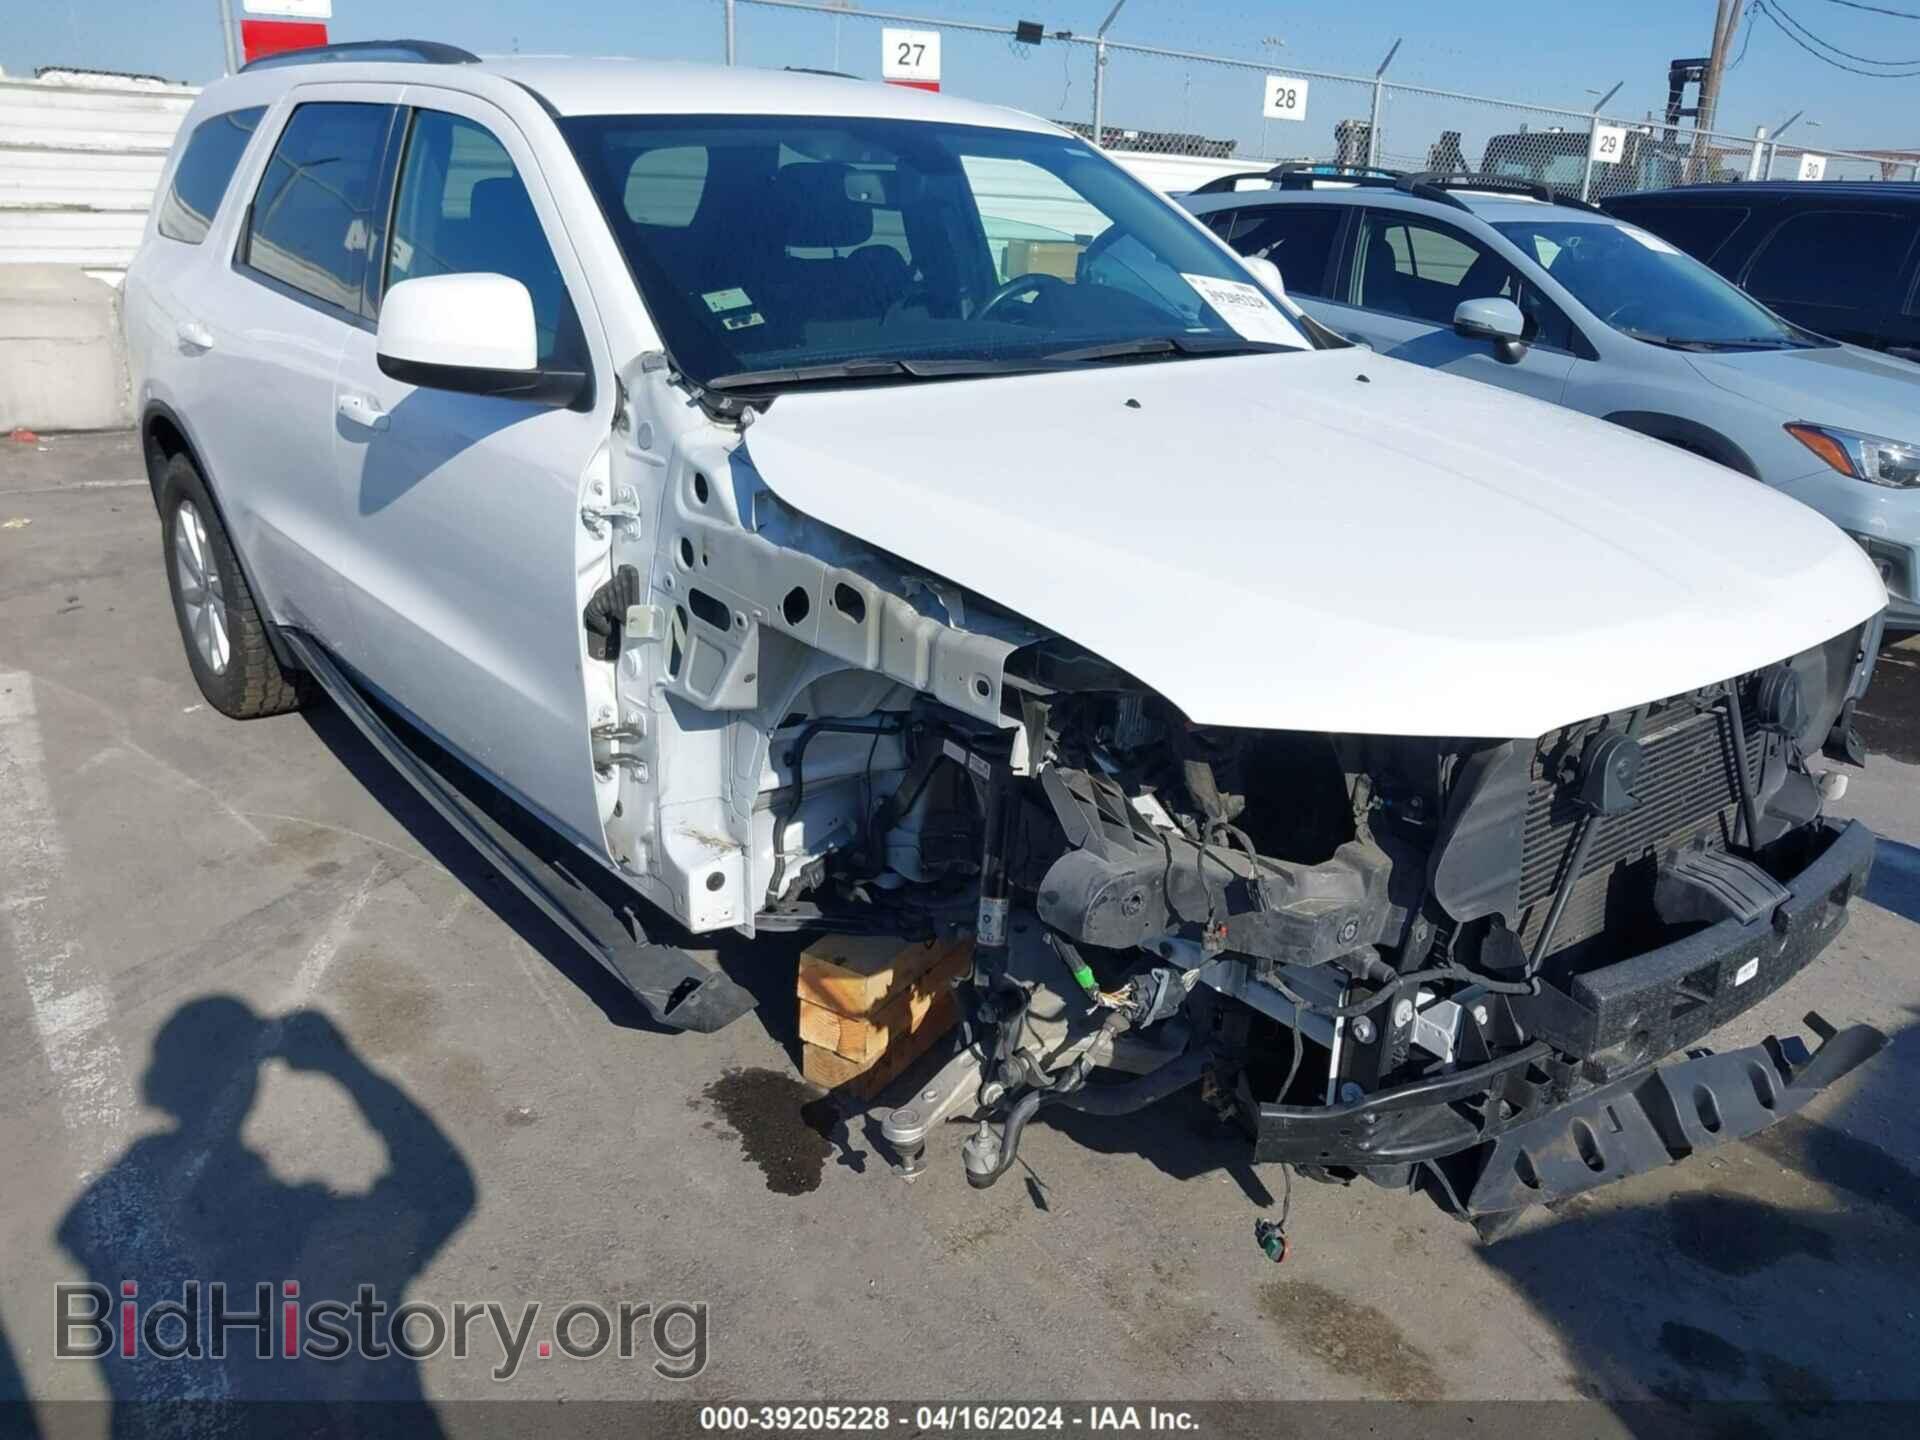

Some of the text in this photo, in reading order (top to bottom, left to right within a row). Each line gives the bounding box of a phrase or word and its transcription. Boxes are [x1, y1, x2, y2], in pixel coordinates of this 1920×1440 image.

[898, 42, 926, 67] 27
[1275, 87, 1297, 109] 28
[1600, 135, 1617, 154] 29
[1805, 162, 1819, 179] 30
